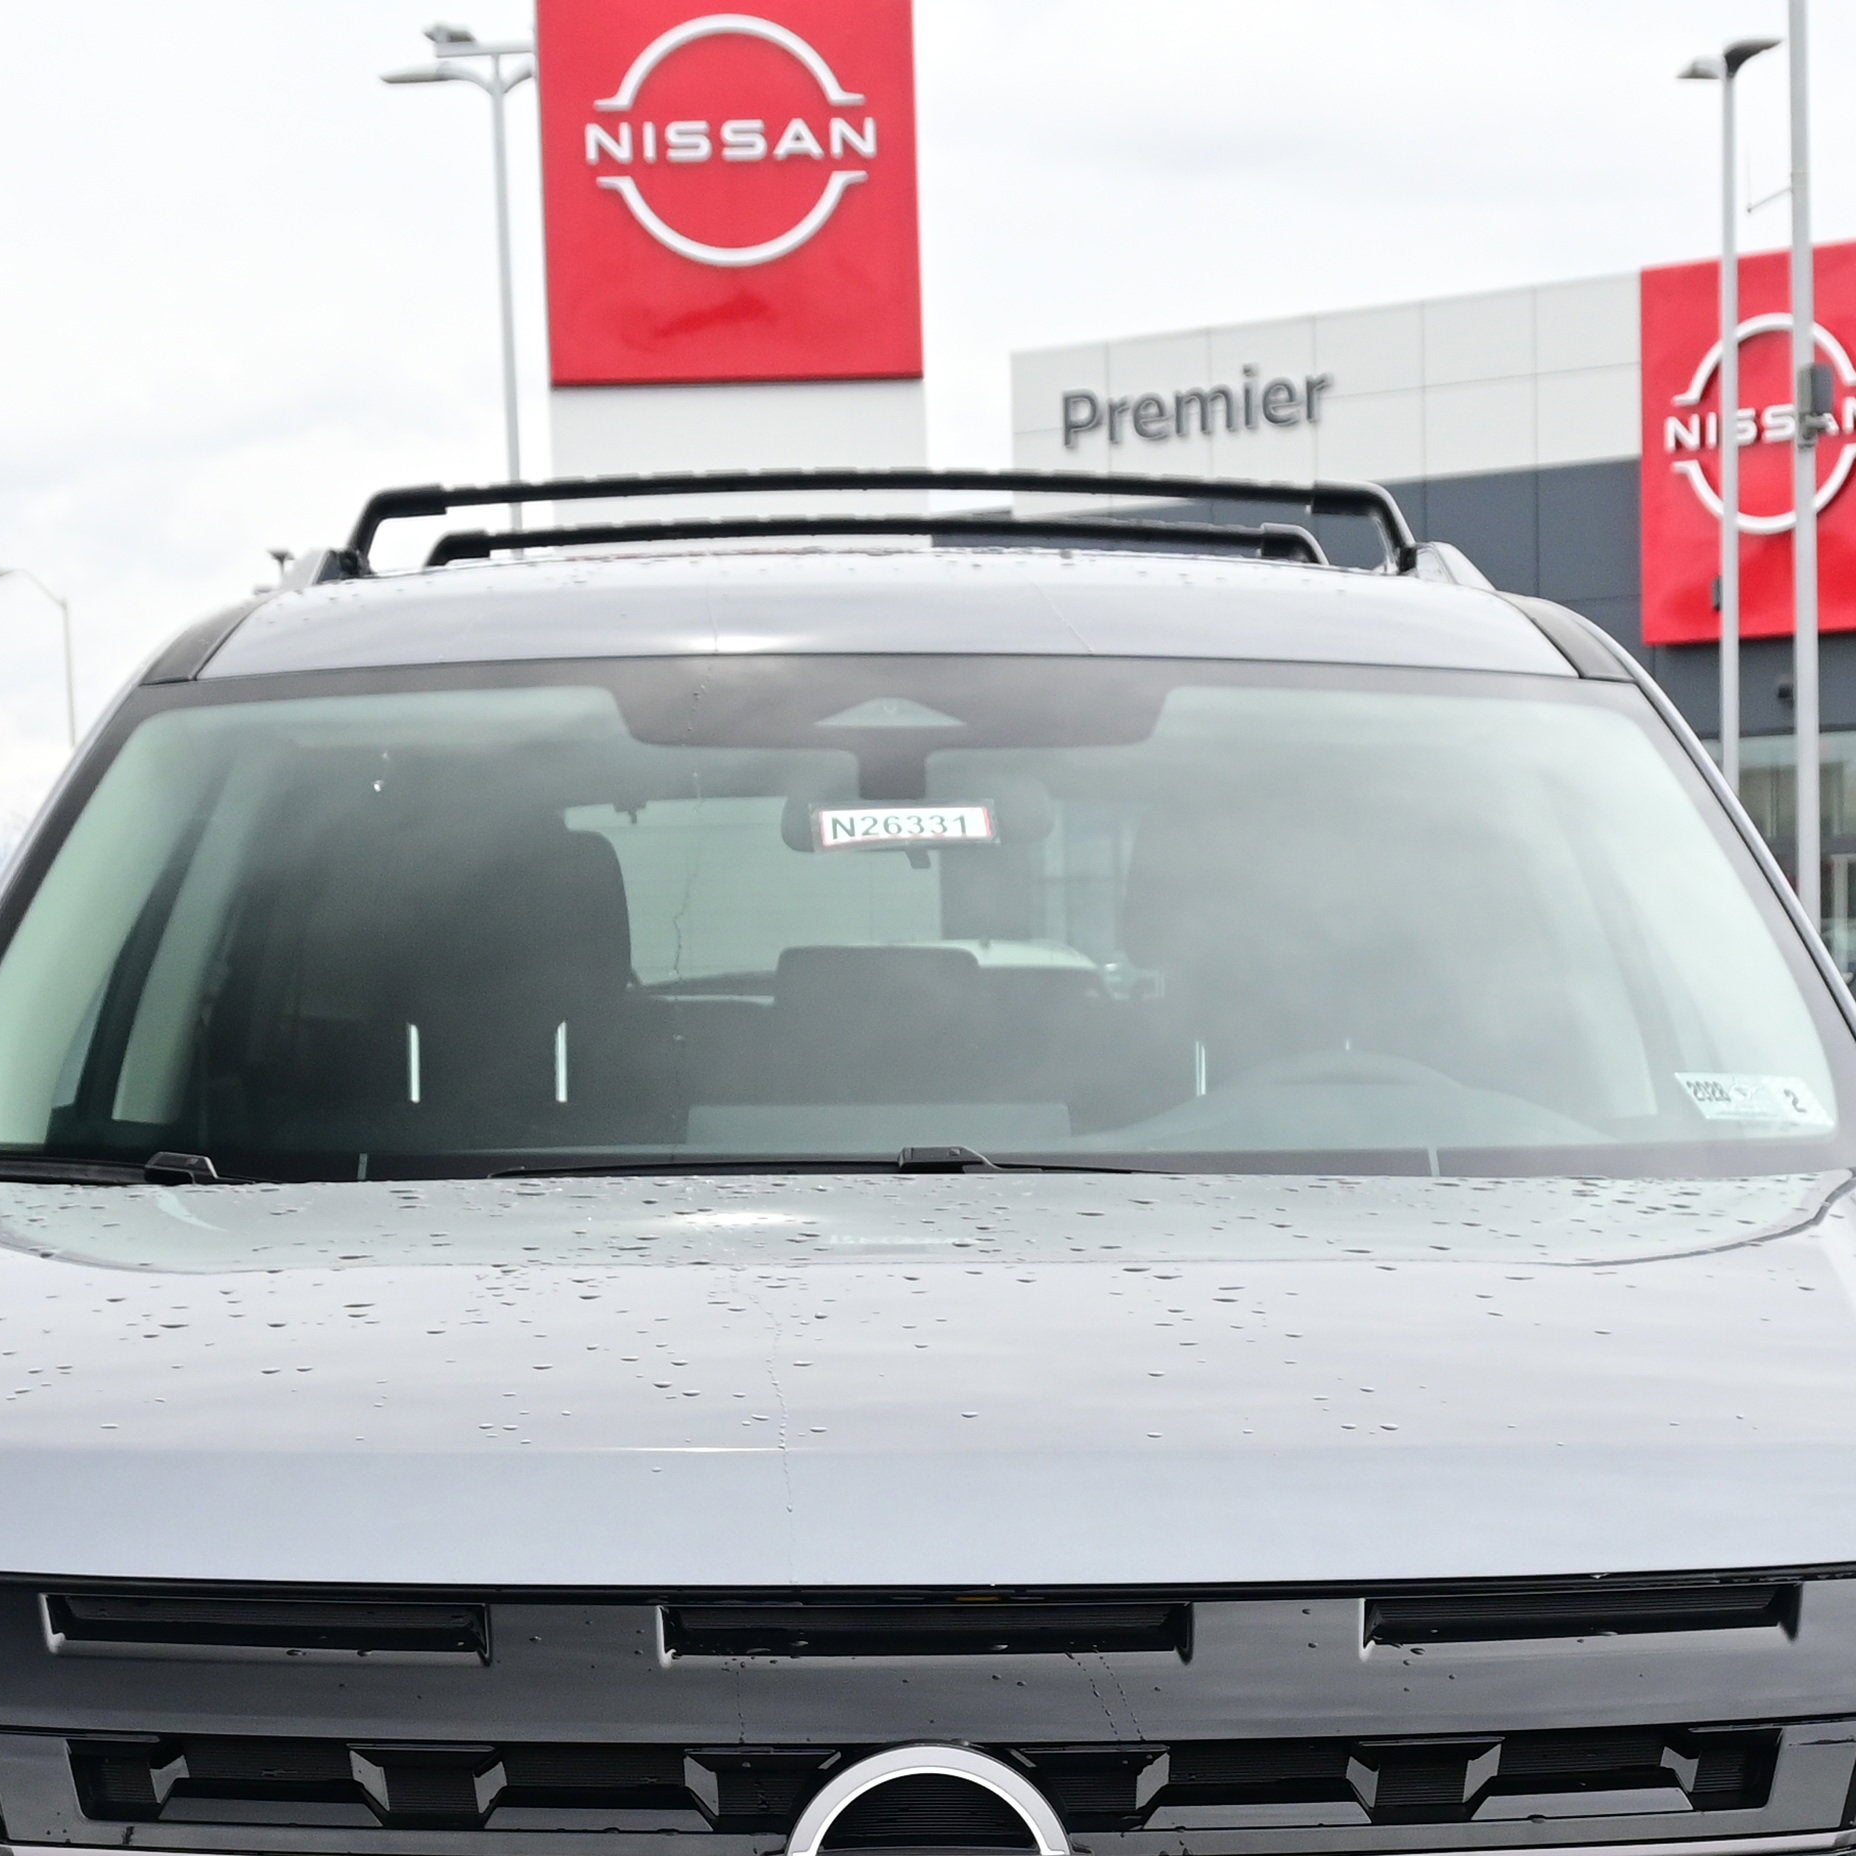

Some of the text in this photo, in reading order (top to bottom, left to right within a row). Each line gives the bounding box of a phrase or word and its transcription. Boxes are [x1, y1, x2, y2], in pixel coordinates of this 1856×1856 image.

[584, 116, 878, 165] NISSAN
[1061, 362, 1334, 449] Premier
[830, 813, 968, 841] N26331
[1783, 1088, 1808, 1114] 2
